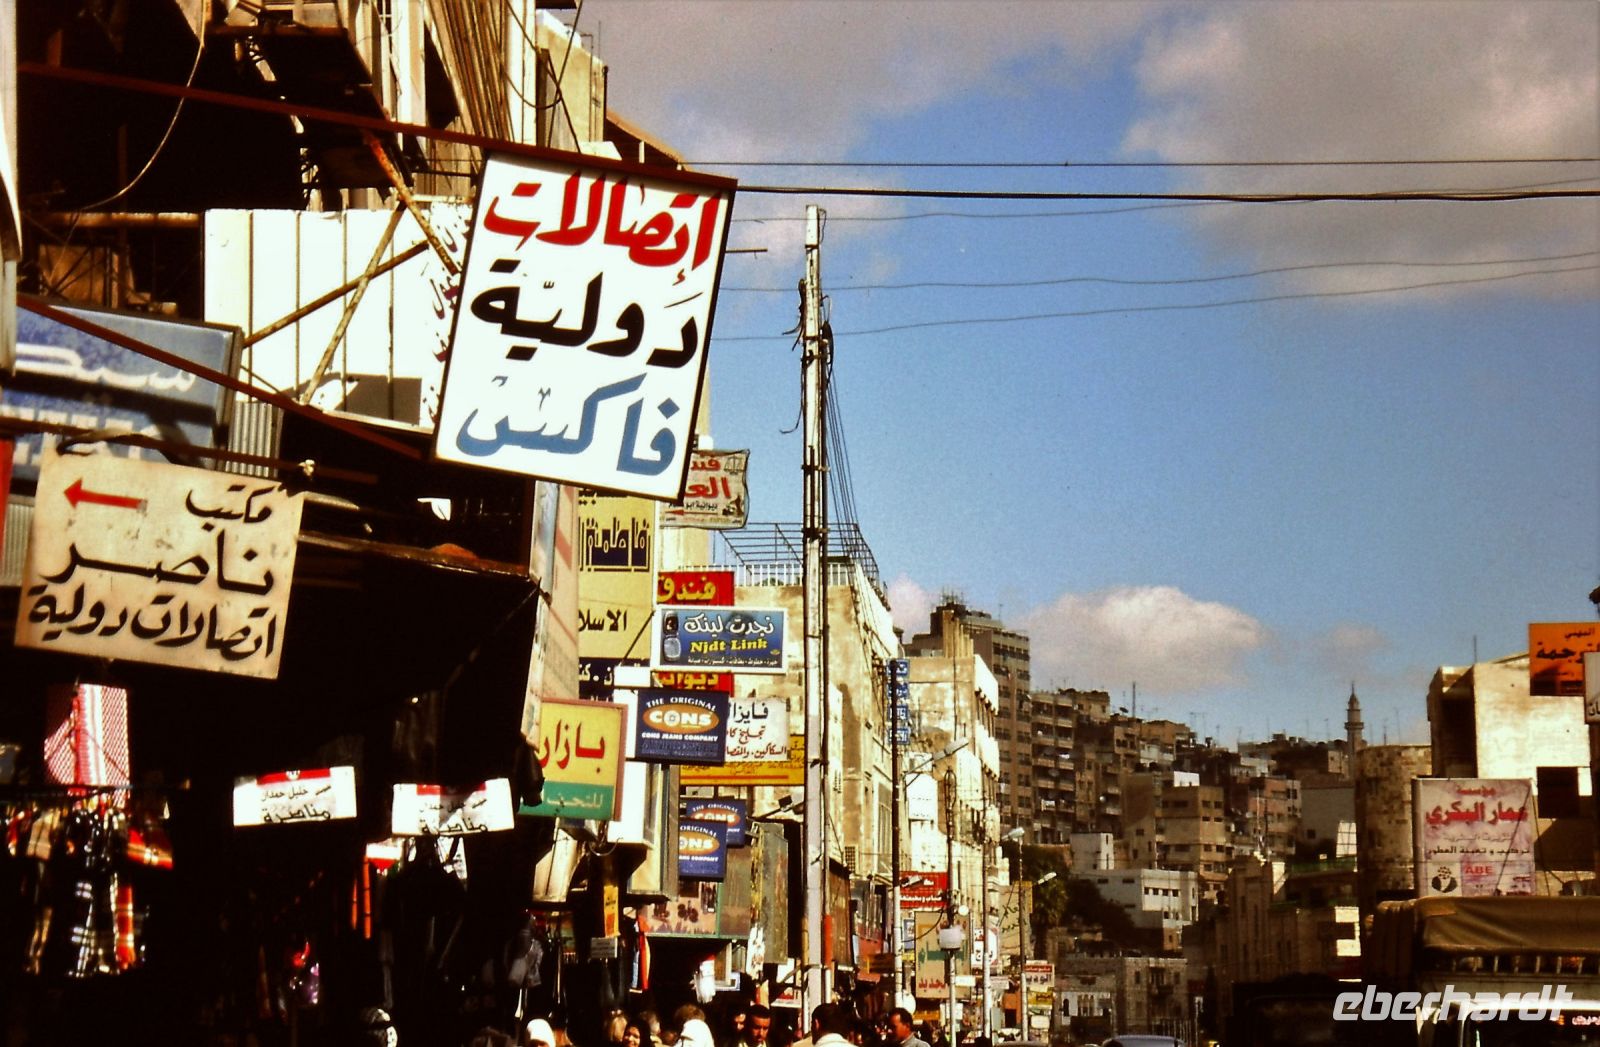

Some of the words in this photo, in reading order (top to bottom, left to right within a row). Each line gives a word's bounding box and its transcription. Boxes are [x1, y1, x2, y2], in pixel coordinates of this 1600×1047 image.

[185, 485, 275, 530] مكتب
[40, 531, 275, 596] ناصر
[657, 575, 716, 603] فندق
[27, 583, 128, 642] دولية
[684, 613, 724, 638] لينك
[729, 614, 775, 635] نجدت
[690, 640, 726, 655] Njdt
[731, 638, 769, 652] Link
[646, 698, 665, 709] THE
[669, 695, 718, 713] ORIGINAL
[648, 709, 713, 727] CONS
[538, 718, 606, 774] بازار
[641, 732, 661, 740] CONS
[684, 734, 719, 743] COMPANY
[726, 745, 750, 759] والمقصا
[680, 826, 717, 838] ORIGINAL
[679, 837, 713, 850] ONS
